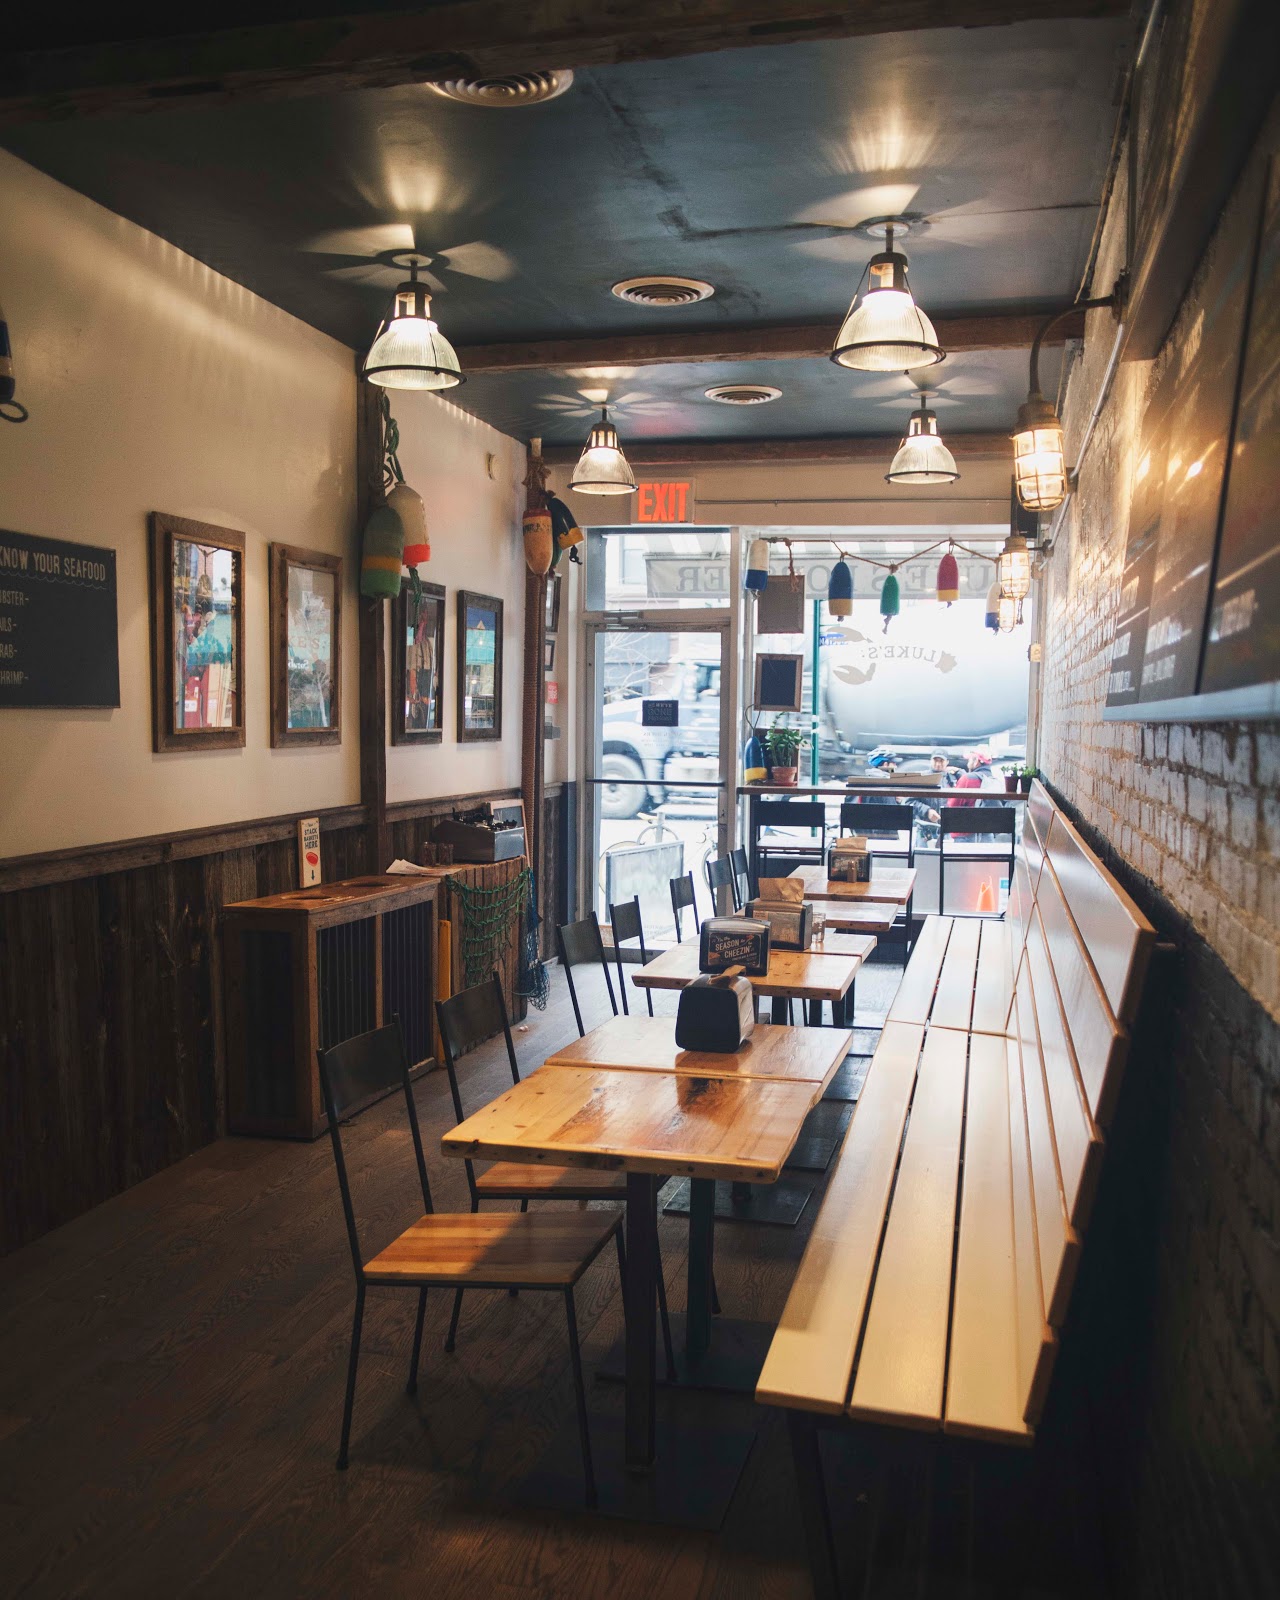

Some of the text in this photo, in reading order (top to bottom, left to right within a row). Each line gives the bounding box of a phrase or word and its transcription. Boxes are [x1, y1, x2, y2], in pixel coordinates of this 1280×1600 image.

[638, 483, 690, 522] EXIT
[33, 552, 60, 575] YOUR
[63, 557, 106, 581] SEAFOOD
[305, 840, 318, 849] HERE
[715, 940, 740, 951] SEASON
